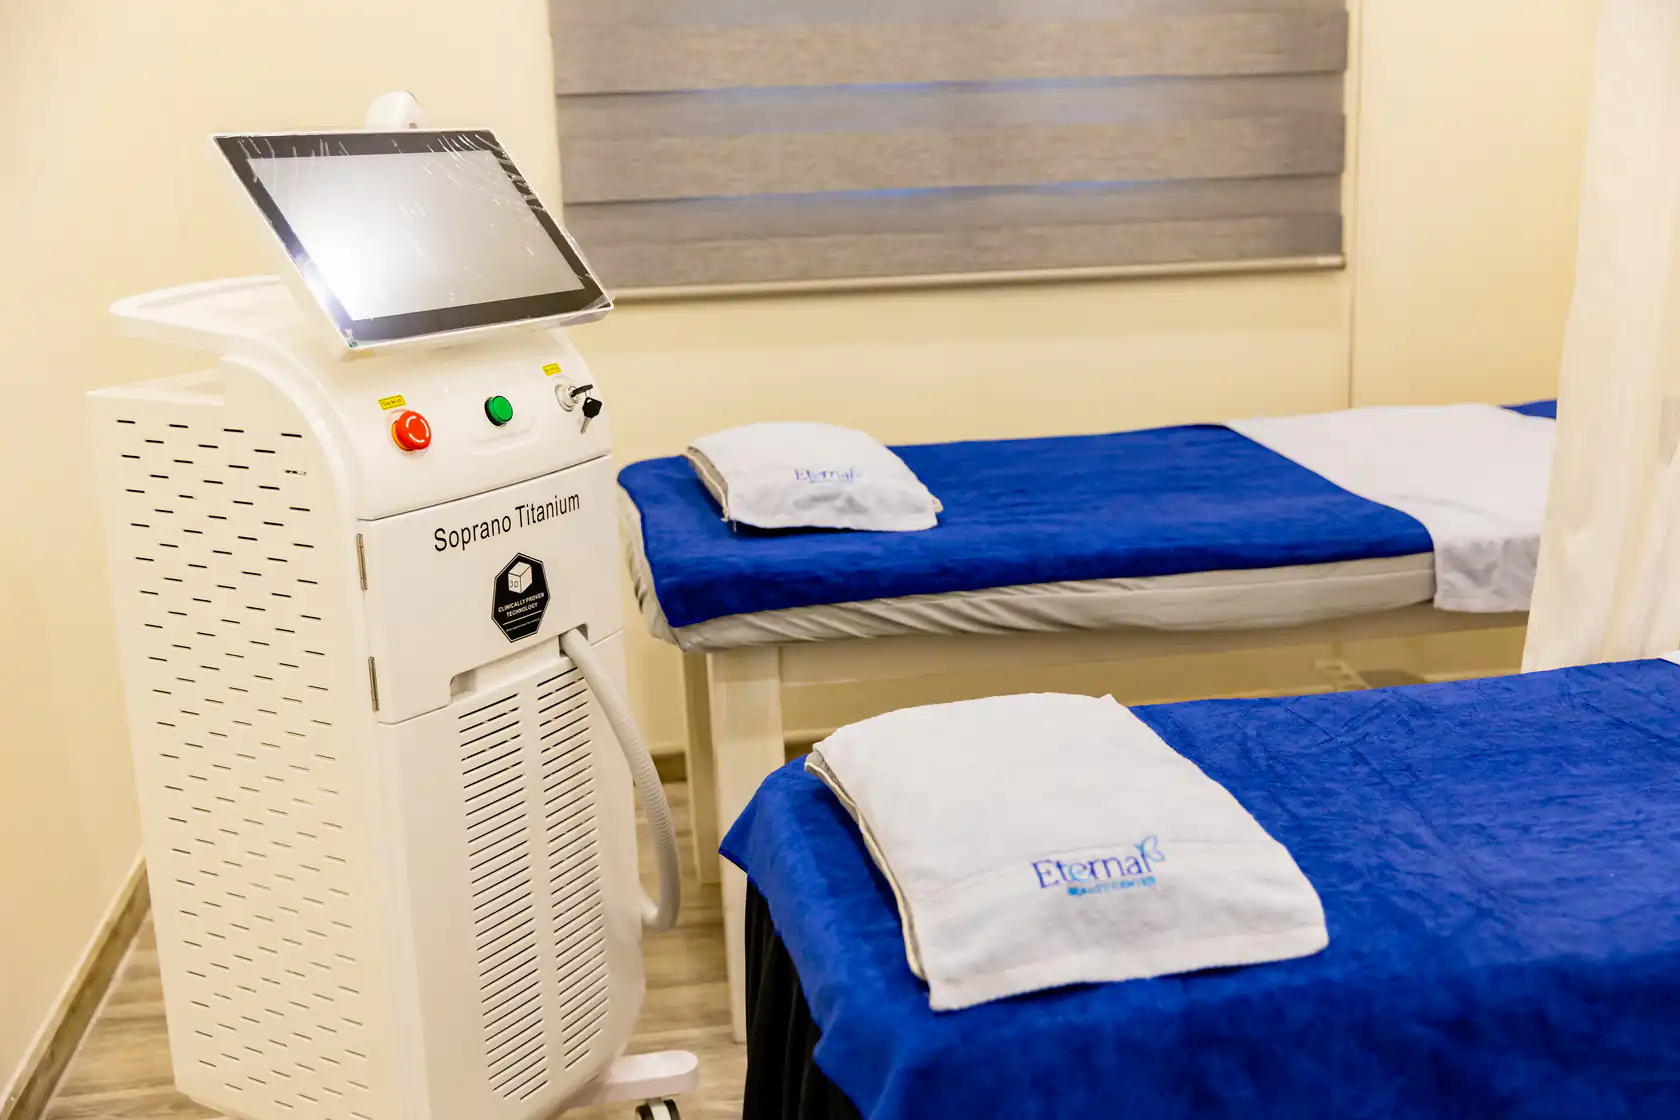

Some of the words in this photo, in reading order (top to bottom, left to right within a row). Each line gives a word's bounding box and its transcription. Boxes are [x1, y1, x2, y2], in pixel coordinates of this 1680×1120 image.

[434, 515, 512, 552] Soprano
[515, 493, 580, 528] Titanium
[509, 580, 519, 588] 3D
[498, 599, 526, 613] CLINICALLY
[525, 592, 545, 604] PROVEN
[506, 602, 538, 617] TECHNOLOGY
[1031, 842, 1153, 889] Eternal
